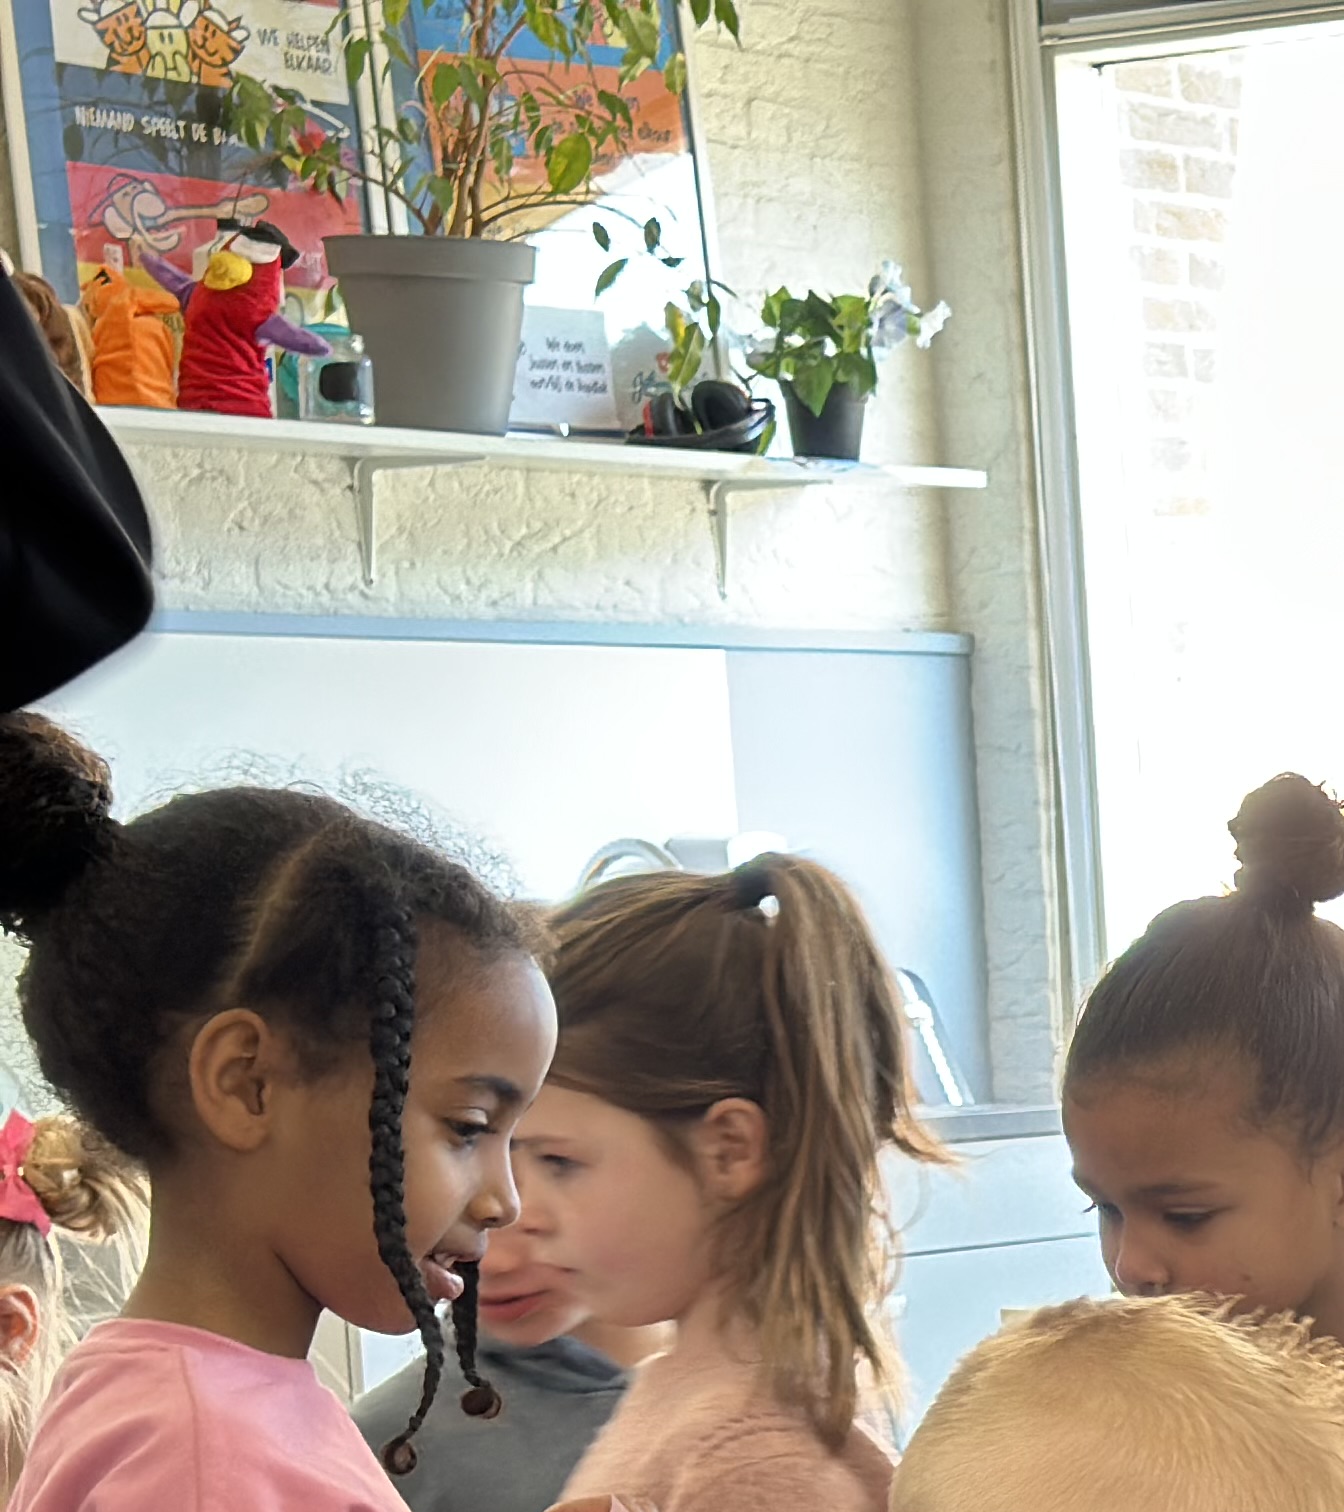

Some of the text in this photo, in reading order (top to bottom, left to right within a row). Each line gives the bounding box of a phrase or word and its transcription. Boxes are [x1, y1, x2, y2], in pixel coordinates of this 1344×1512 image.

[257, 28, 279, 46] WE
[75, 105, 135, 133] NIEMAND
[140, 115, 187, 140] SPEELT
[191, 122, 208, 143] DE
